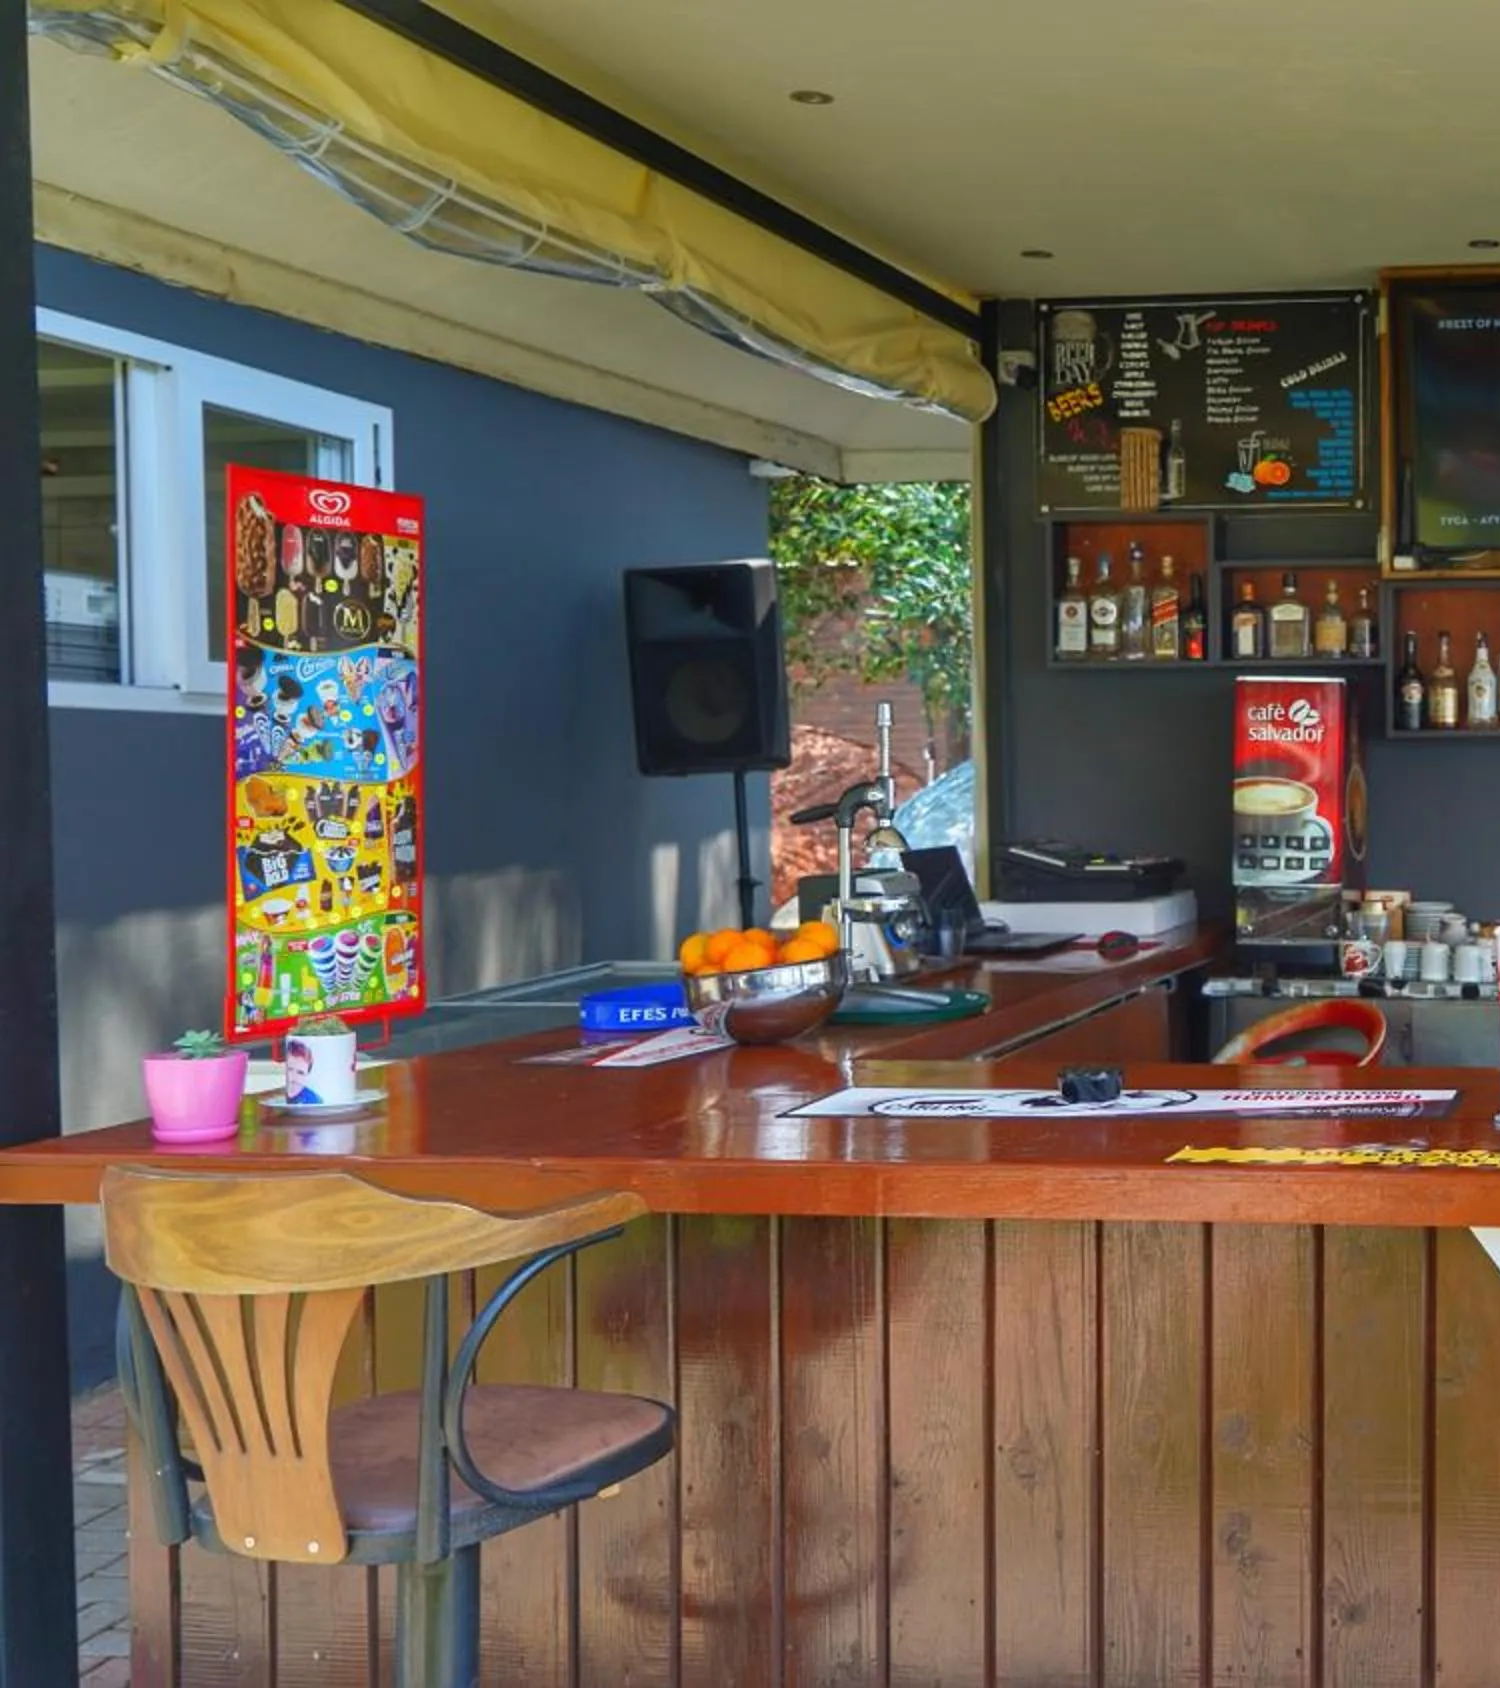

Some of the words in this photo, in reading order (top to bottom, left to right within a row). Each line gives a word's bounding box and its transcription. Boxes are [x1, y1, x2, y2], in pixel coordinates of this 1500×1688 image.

[310, 514, 351, 527] ALGIDA
[343, 606, 365, 629] M
[1248, 724, 1325, 744] salvador
[619, 1007, 667, 1023] EFES
